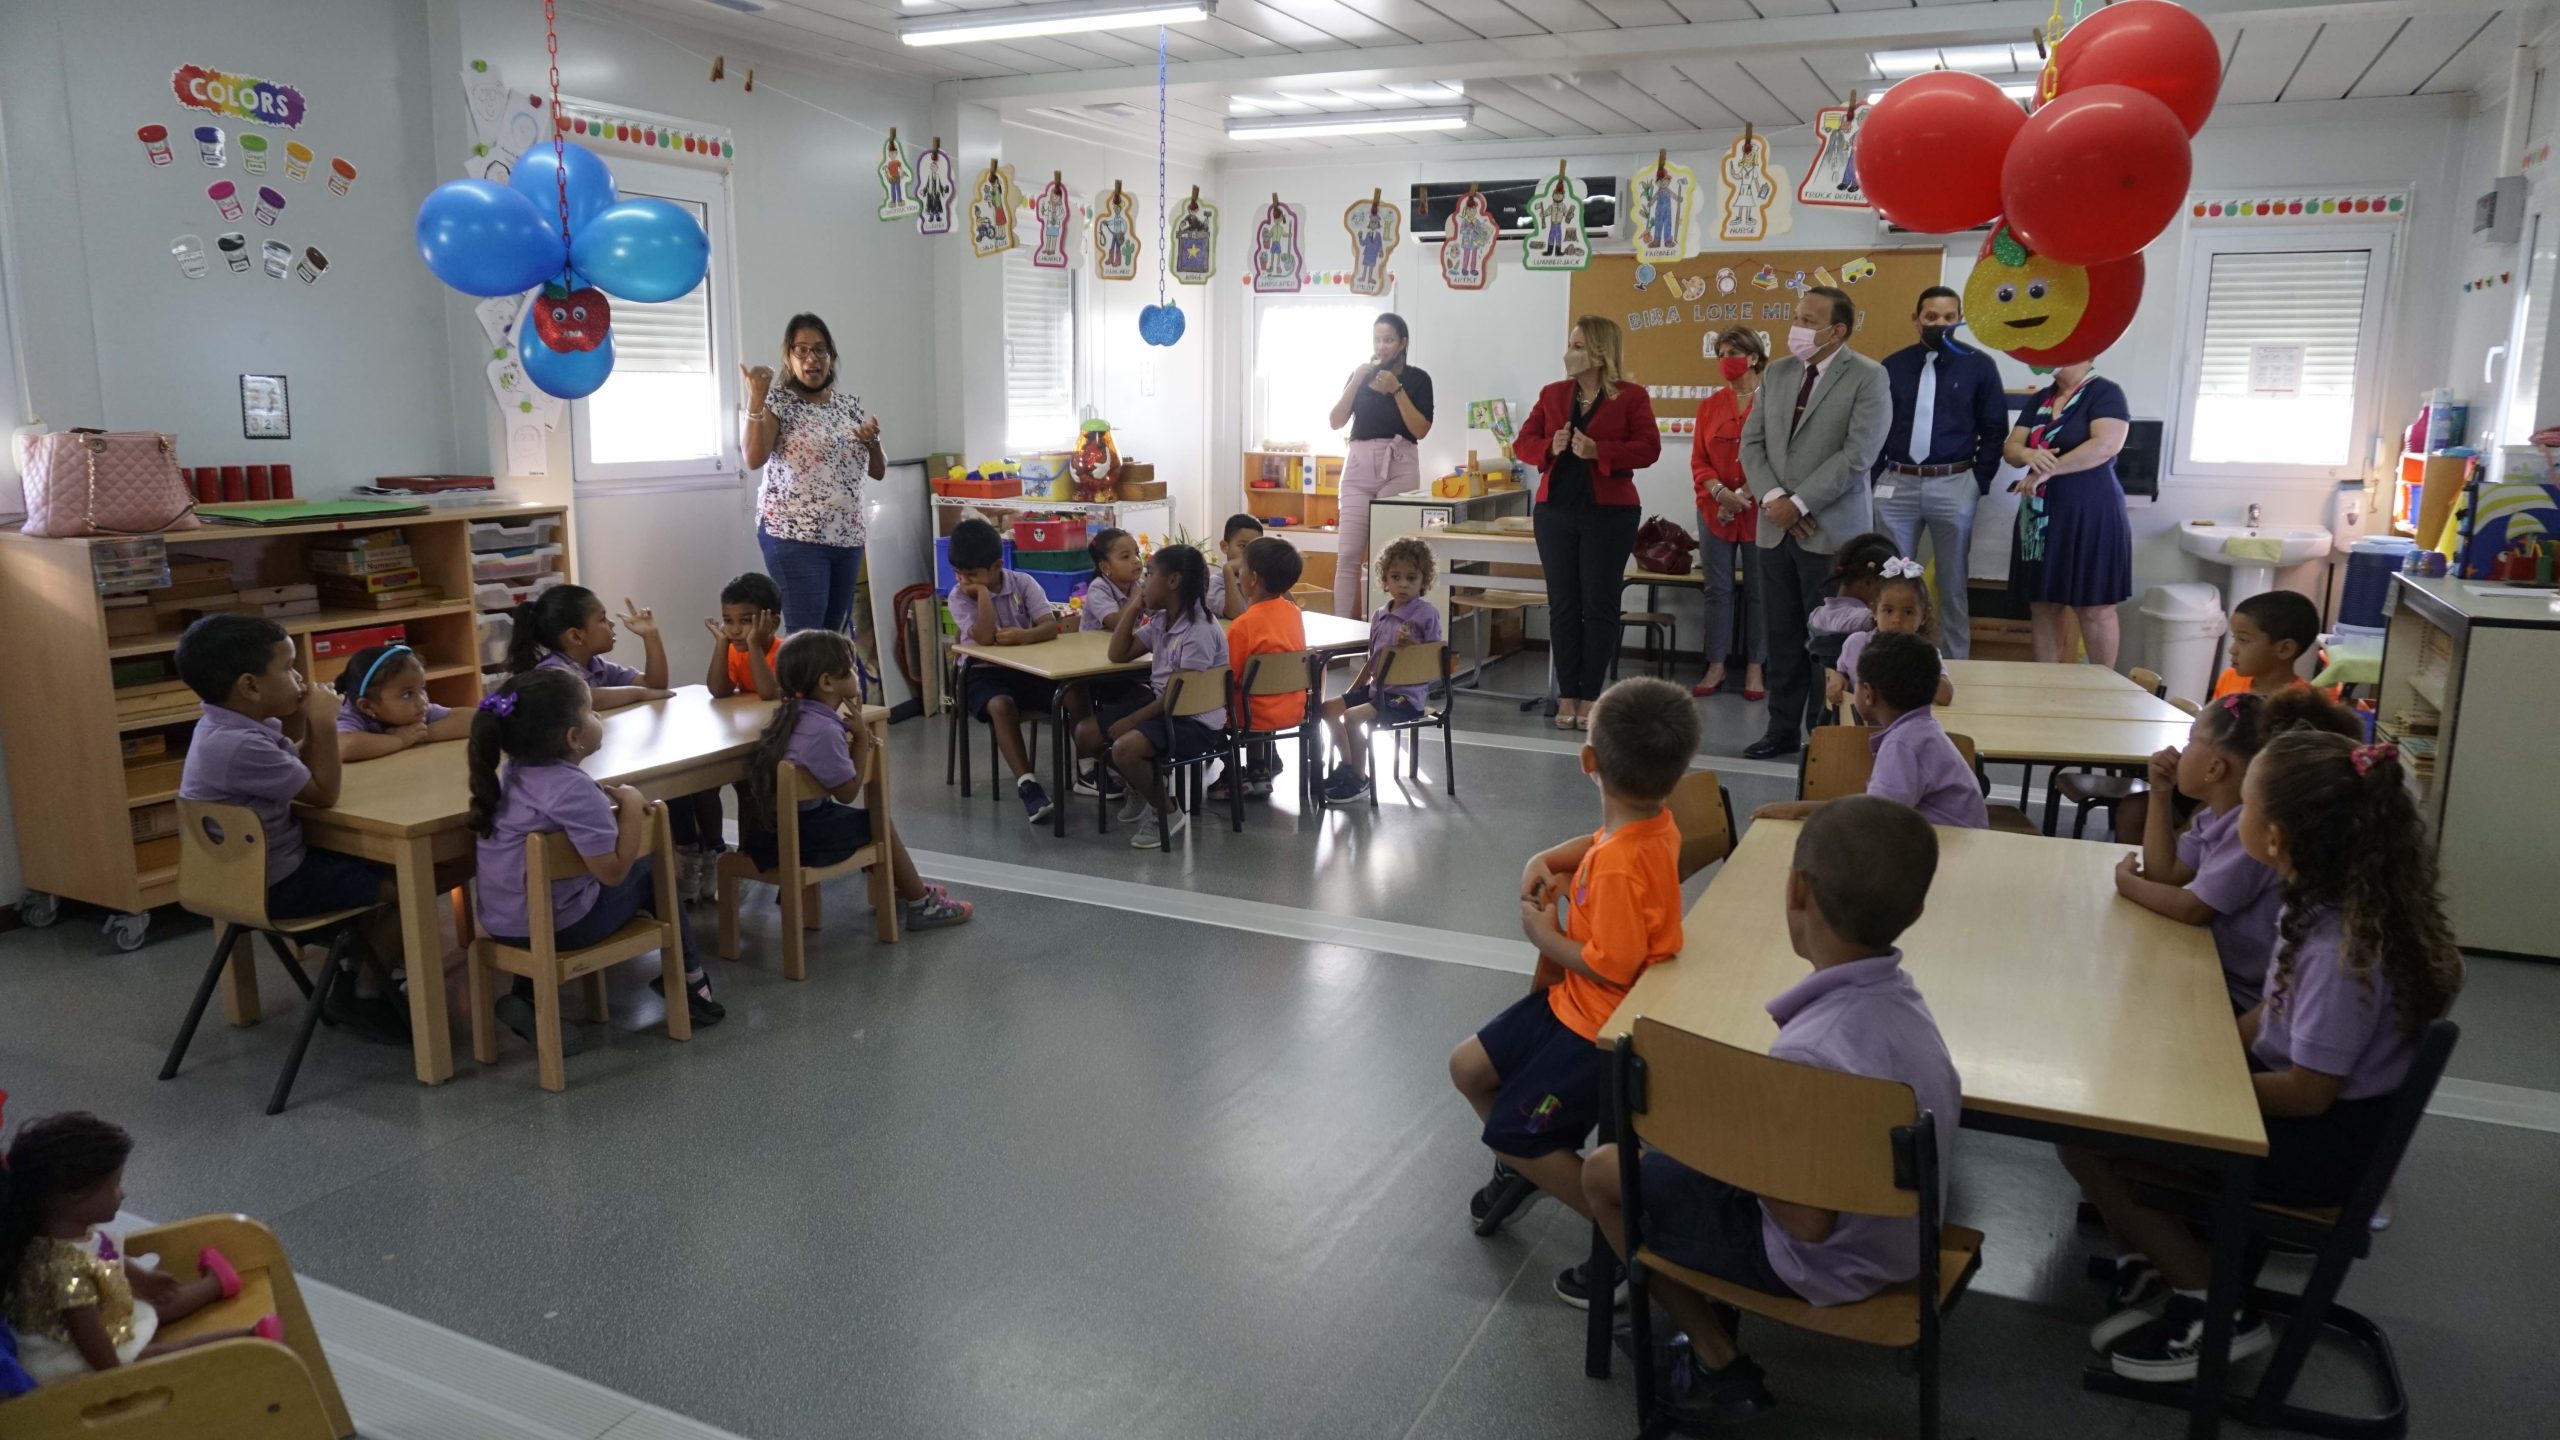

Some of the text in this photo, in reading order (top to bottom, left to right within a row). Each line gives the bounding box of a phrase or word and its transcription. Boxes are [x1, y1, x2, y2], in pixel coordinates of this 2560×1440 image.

[189, 77, 289, 117] COLORS
[1628, 306, 1682, 331] BIRA
[1693, 302, 1754, 321] LOKE
